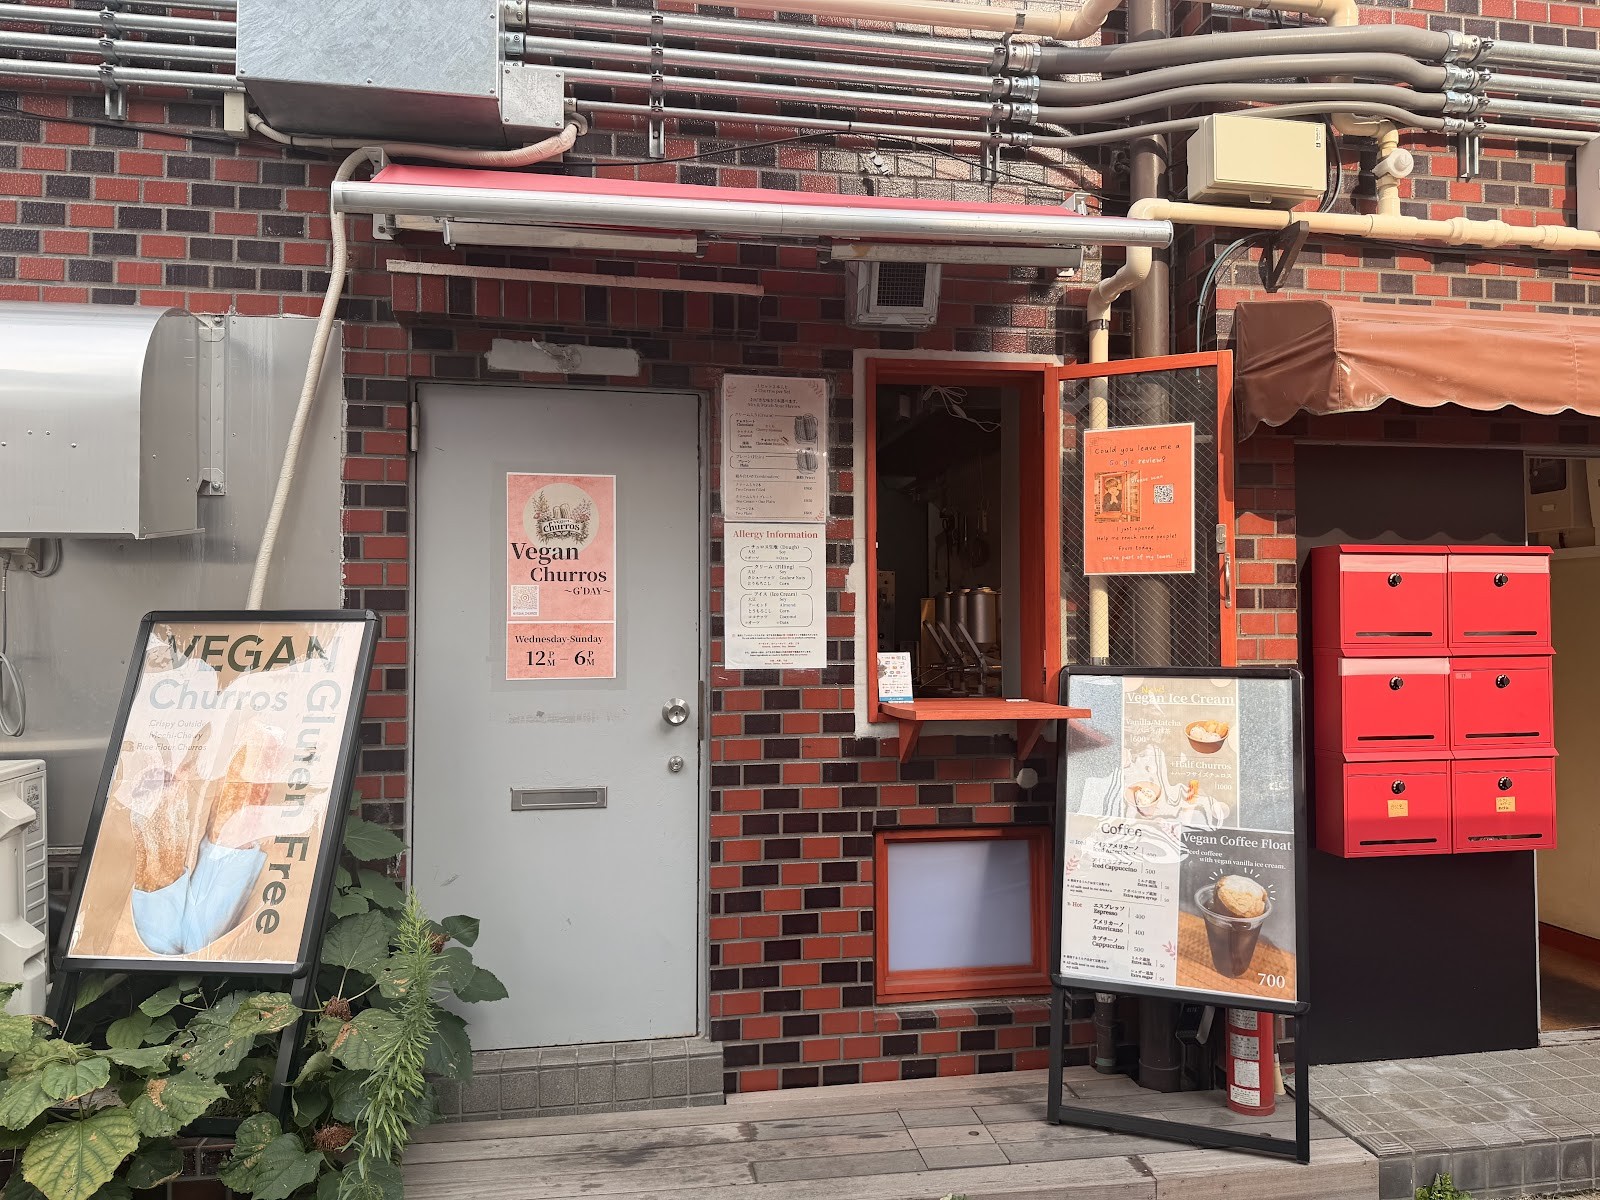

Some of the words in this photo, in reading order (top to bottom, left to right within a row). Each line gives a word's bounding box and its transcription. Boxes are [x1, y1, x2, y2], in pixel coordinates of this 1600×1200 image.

[1095, 446, 1117, 455] Could
[1120, 447, 1134, 456] you
[1138, 444, 1157, 452] leave
[1138, 455, 1166, 464] review?
[733, 529, 764, 540] Allergy
[767, 530, 818, 539] Information
[511, 542, 579, 566] Vegan
[531, 566, 607, 582] Churros
[515, 634, 603, 645] Wednesday-Sunday
[166, 635, 341, 675] VEGAN
[527, 650, 546, 666] 12
[575, 649, 586, 666] 6
[149, 678, 289, 713] Churros
[1127, 692, 1165, 705] Vegan
[1169, 693, 1188, 703] Ice
[1191, 693, 1234, 705] Cream
[150, 719, 176, 730] Crispy
[281, 678, 342, 819] Gluten
[1196, 761, 1232, 770] Churros
[1101, 822, 1142, 837] Coffee
[1183, 832, 1218, 846] Vegan
[1220, 835, 1258, 849] Coffee
[1261, 838, 1292, 851] Float
[1105, 863, 1138, 873] Cappuccino
[1214, 858, 1232, 866] vegan
[1233, 859, 1254, 867] vanilla
[255, 834, 309, 935] Free
[1093, 908, 1118, 917] Espresso
[1094, 903, 1125, 912] エスプレッソ
[1093, 918, 1124, 928] アメリカーノ
[1093, 924, 1124, 934] Americano
[1092, 940, 1125, 951] Cappuccino
[1257, 972, 1286, 989] 700
